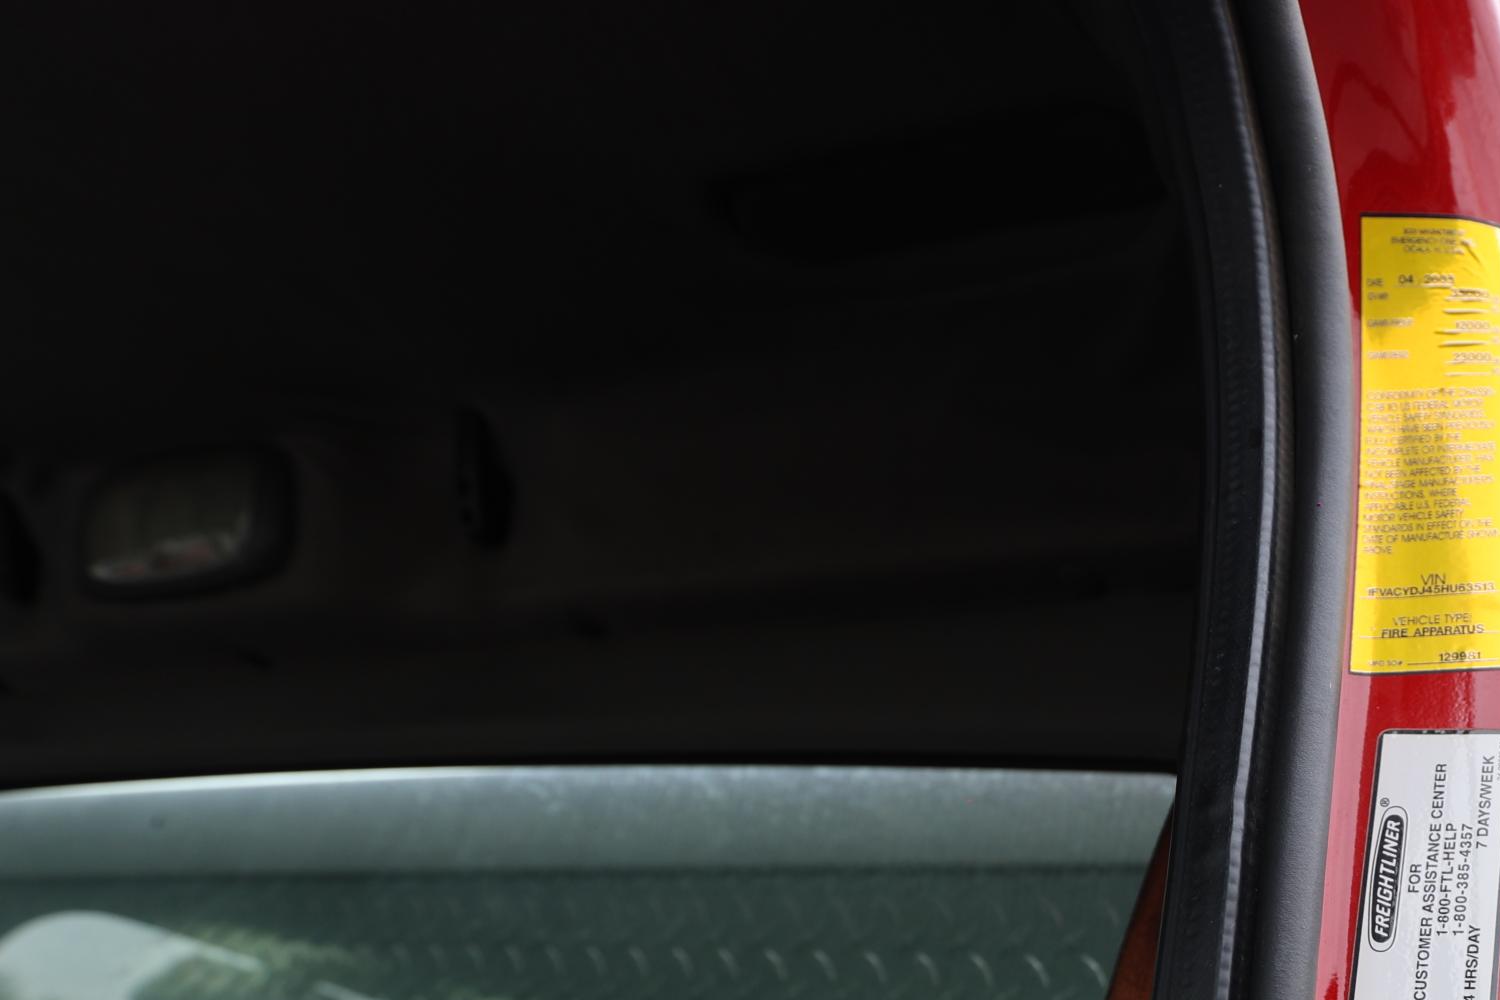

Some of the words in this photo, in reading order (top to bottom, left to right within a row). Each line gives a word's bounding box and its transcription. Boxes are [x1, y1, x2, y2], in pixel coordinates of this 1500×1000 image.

[1420, 573, 1446, 585] VIN
[1381, 627, 1408, 638] FIRE
[1414, 624, 1485, 637] APPARATUS
[1392, 614, 1440, 626] VEHICLE
[1430, 763, 1447, 819] CENTER
[1477, 755, 1495, 837] DAYS/WEEK
[1422, 823, 1441, 913] ASSISTANCE
[1475, 840, 1487, 849] 7
[1374, 819, 1401, 937] FREIGHTLINER
[1408, 864, 1421, 893] FOR
[1436, 823, 1457, 936] 1-800-FTL-HELP
[1452, 823, 1473, 936] 1-800-385-4357
[1413, 917, 1433, 1000] CUSTOMER
[1464, 925, 1480, 990] HRS/DAY
